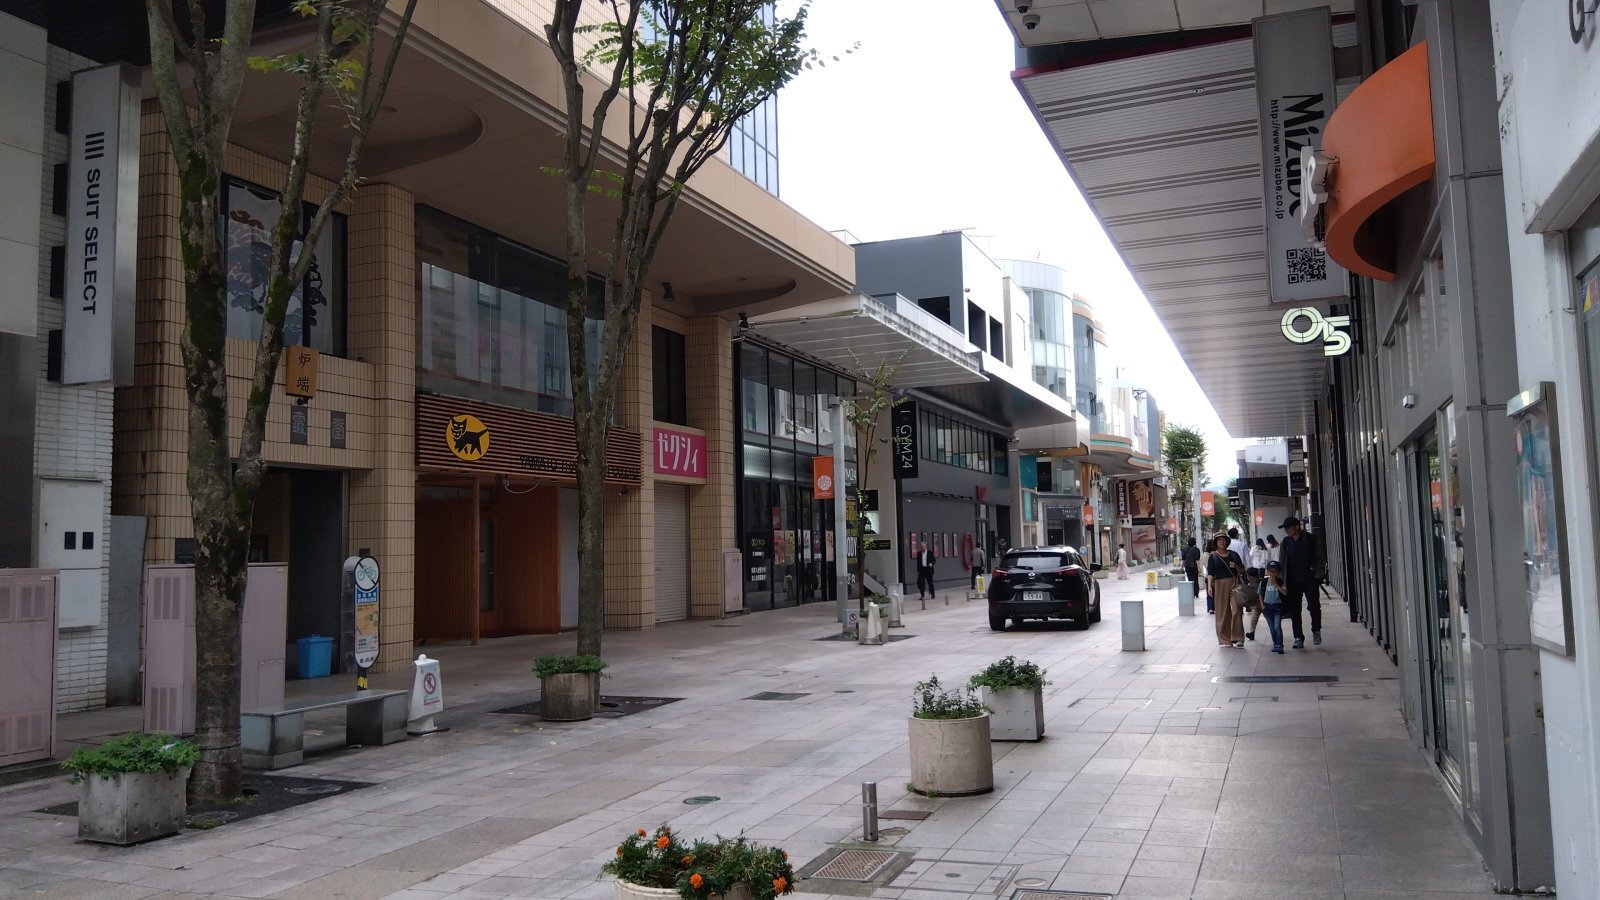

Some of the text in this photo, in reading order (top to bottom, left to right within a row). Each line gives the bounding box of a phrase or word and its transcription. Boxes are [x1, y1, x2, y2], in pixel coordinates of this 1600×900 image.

[1270, 99, 1285, 219] http://www.mizube.co.jp
[83, 168, 100, 315] SUIT SELECT
[296, 353, 311, 392] 炉端
[657, 432, 698, 473] ゼクシィ
[900, 424, 913, 468] GYM24
